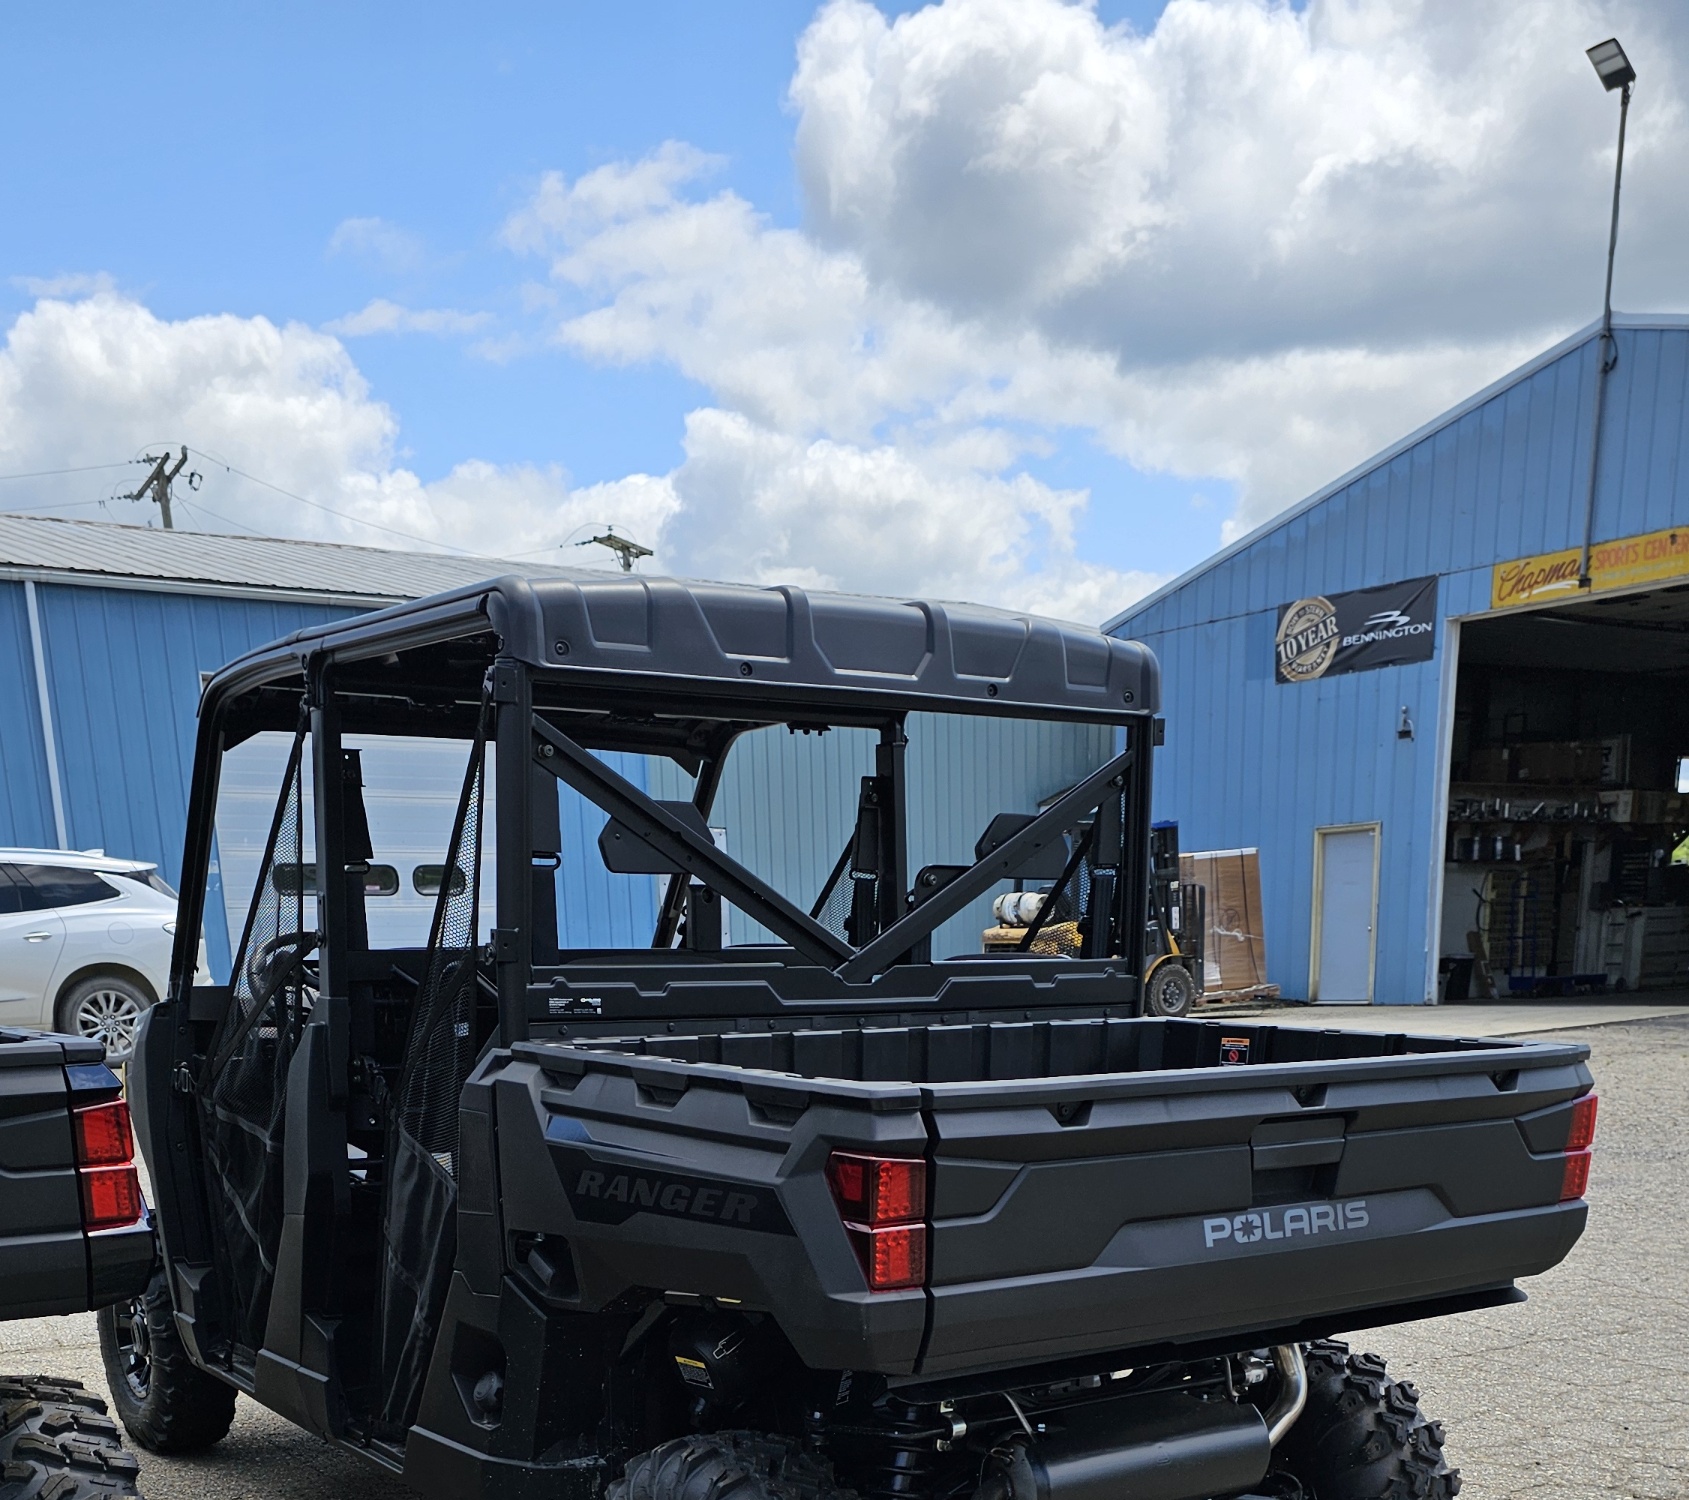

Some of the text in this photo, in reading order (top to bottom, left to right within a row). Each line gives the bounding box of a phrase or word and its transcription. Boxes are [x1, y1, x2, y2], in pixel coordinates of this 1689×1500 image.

[1594, 543, 1639, 571] SPORTS
[1277, 616, 1339, 665] 10 YEAR
[1343, 622, 1432, 647] BENNINGTON
[576, 1169, 759, 1223] RANGER
[1203, 1200, 1370, 1248] POLARIS
